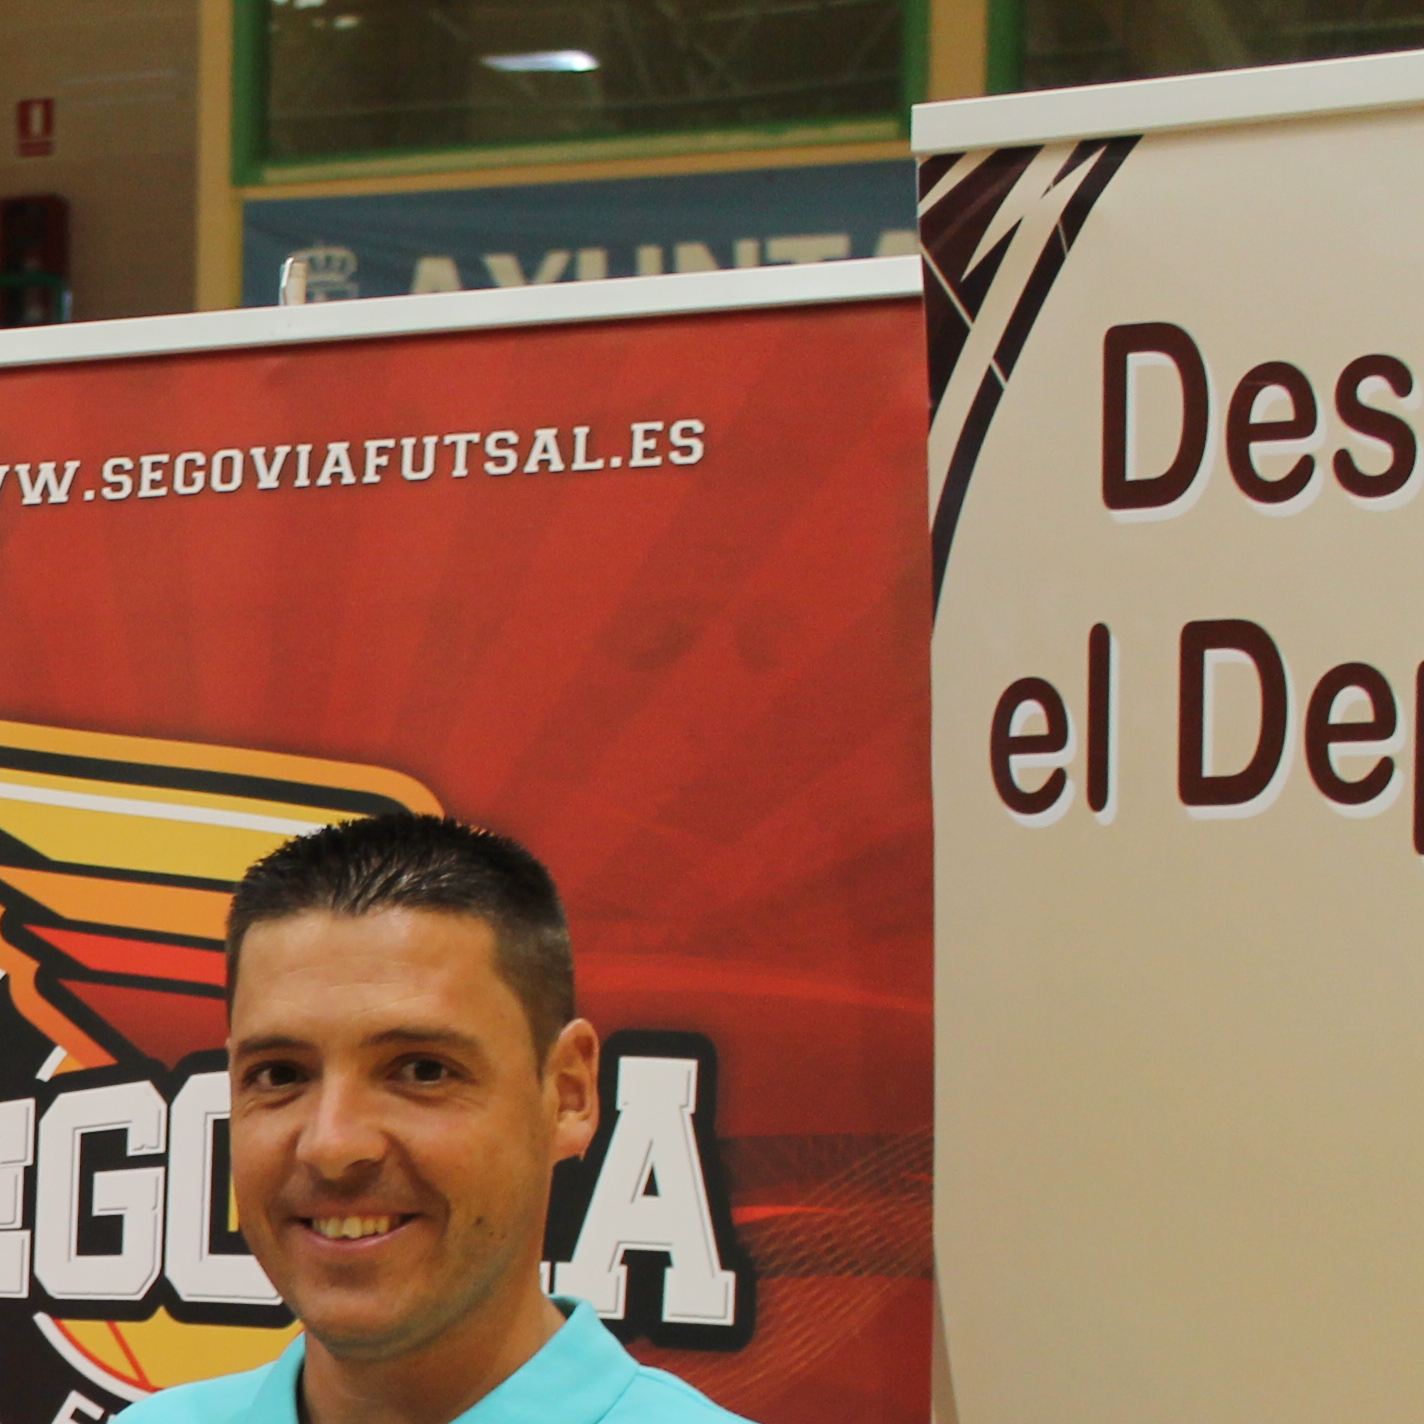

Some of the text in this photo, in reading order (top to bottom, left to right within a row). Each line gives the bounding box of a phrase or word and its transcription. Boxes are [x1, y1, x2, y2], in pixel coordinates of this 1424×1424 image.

[1102, 321, 1418, 513] Des
[990, 618, 1424, 857] el De
